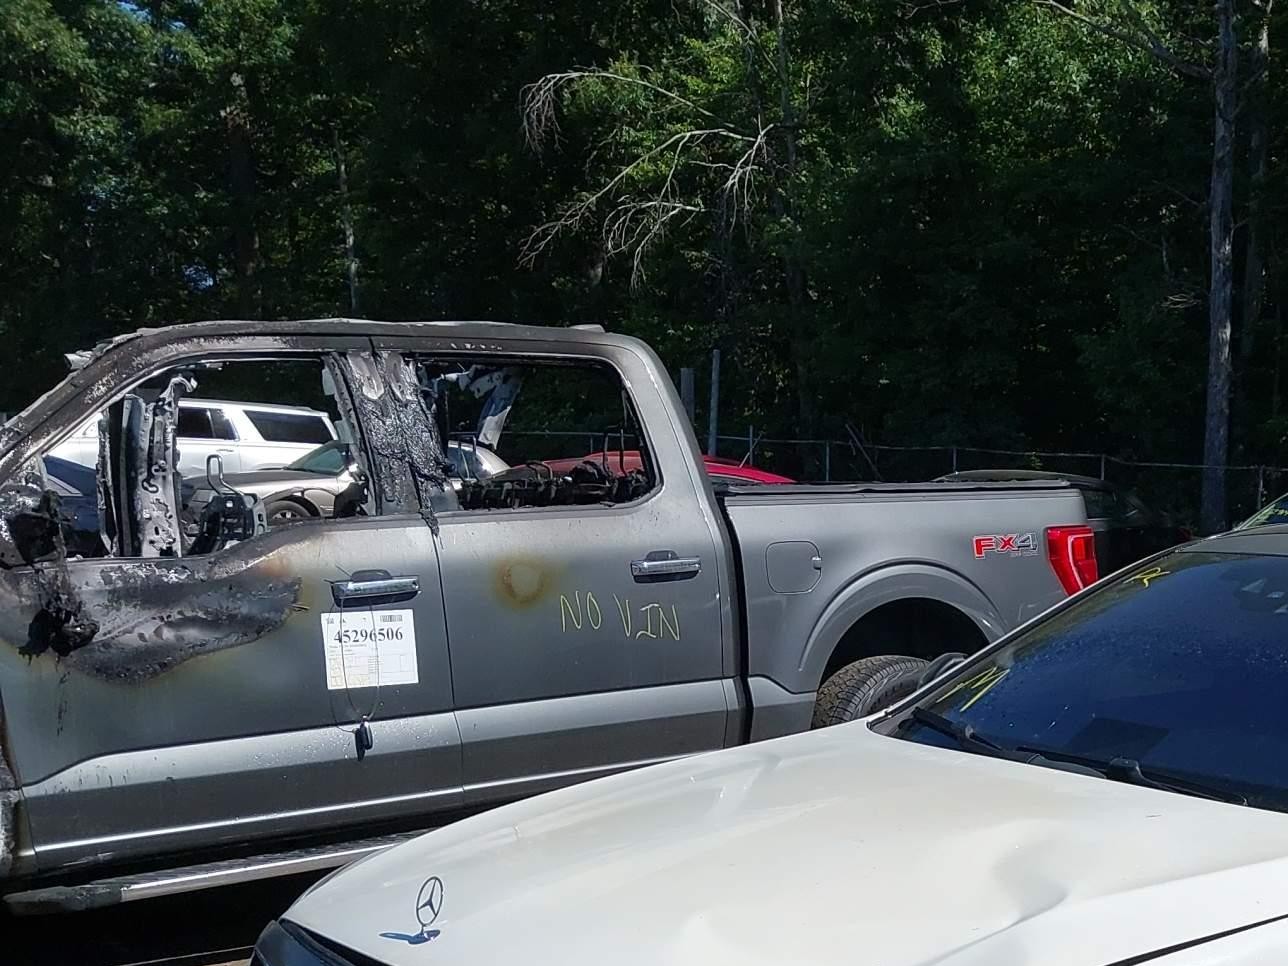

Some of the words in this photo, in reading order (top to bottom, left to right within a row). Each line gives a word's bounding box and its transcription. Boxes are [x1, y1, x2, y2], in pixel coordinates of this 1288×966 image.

[973, 533, 1039, 559] FX4
[560, 590, 602, 633] NO
[612, 593, 680, 641] VIN
[333, 626, 404, 644] 45296506
